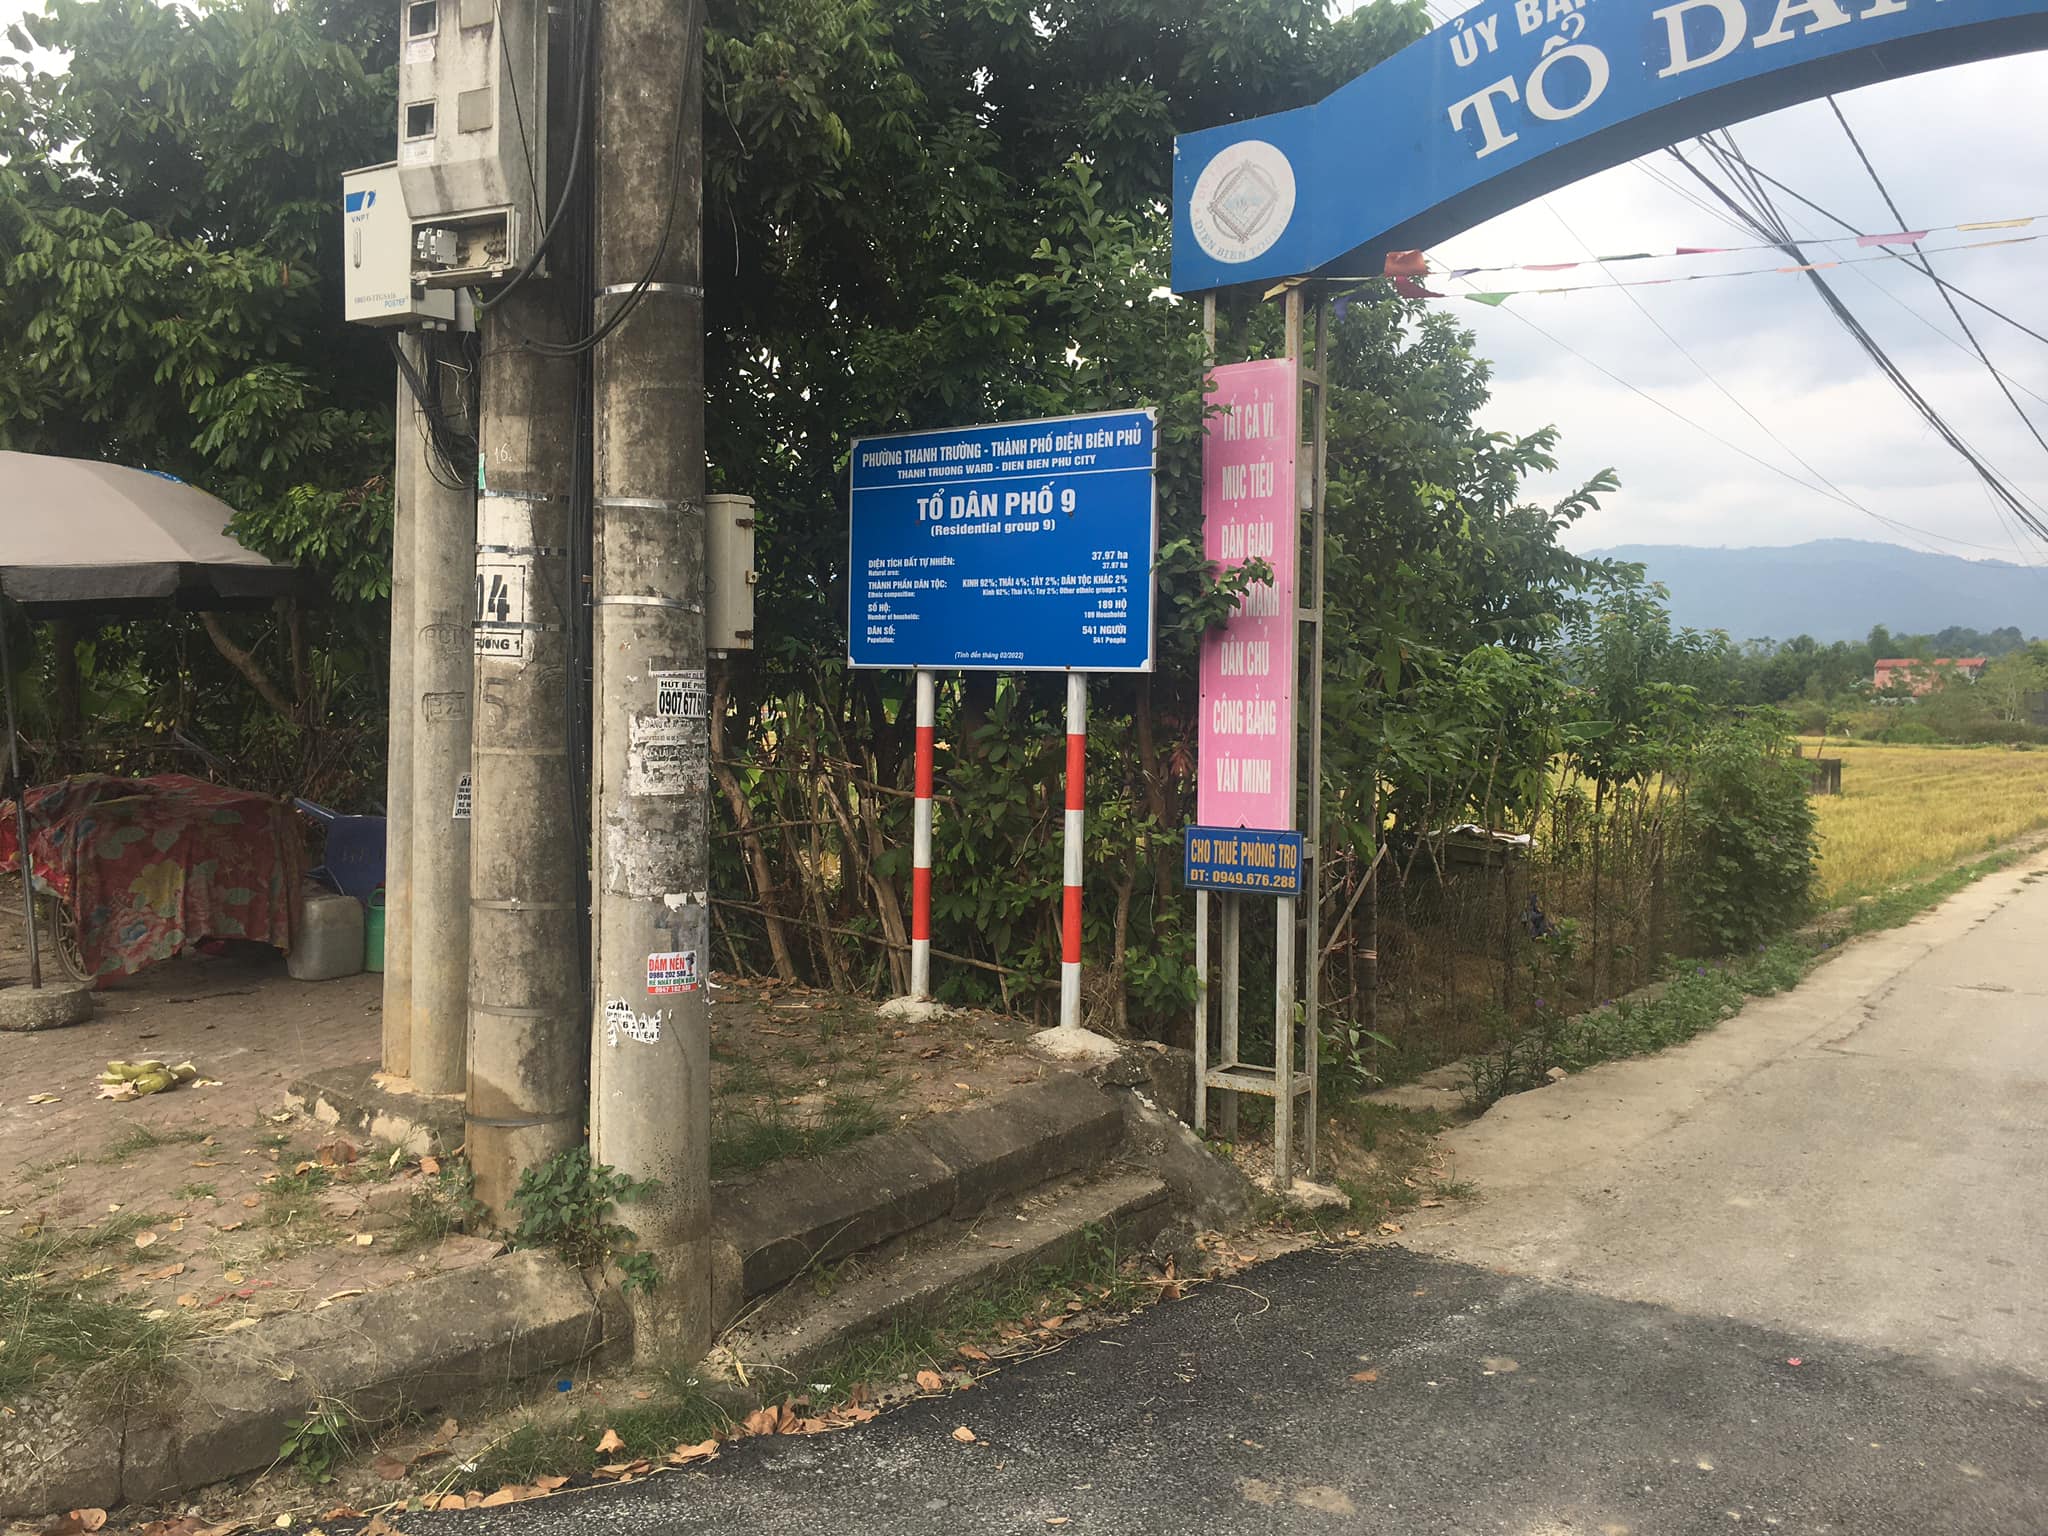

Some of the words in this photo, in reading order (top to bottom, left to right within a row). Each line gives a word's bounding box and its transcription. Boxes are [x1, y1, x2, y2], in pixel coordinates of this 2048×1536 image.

[1450, 14, 1498, 67] ỦY
[1448, 12, 1610, 160] TỔ
[1245, 388, 1259, 440] CẢ
[862, 447, 902, 468] PHƯỜNG
[904, 447, 937, 465] THANH
[940, 440, 981, 461] TRƯỜNG
[991, 437, 1027, 457] THÀNH
[1030, 431, 1053, 454] PHỐ
[1055, 431, 1082, 454] ĐIỆN
[1086, 428, 1113, 449] BIÊN
[1117, 421, 1142, 446] PHỦ
[897, 468, 926, 480] THANH
[928, 466, 963, 477] TRUONG
[965, 463, 993, 474] WARD
[1002, 460, 1024, 471] DIEN
[1027, 458, 1049, 470] BIEN
[1052, 457, 1071, 467] PHU
[1074, 455, 1096, 465] CITY
[1222, 464, 1246, 508] MỤC
[917, 488, 945, 520] TỔ
[950, 490, 998, 519] DÂN
[1005, 481, 1055, 516] PHỐ
[1061, 488, 1076, 513] 9
[931, 522, 1001, 537] (Residential
[1004, 521, 1039, 534] group
[1042, 519, 1055, 531] 9)
[1220, 516, 1244, 560] DÂN
[887, 558, 902, 568] TÍCH
[1117, 551, 1128, 559] ha
[868, 579, 892, 590] THÀNH
[914, 579, 929, 588] DÂN
[1061, 575, 1076, 584] DÂN
[1078, 574, 1092, 586] TỘC
[1093, 573, 1113, 584] KHÁC
[1115, 575, 1127, 583] 2%
[868, 601, 877, 612] SỐ
[879, 602, 891, 613] HỘ:
[1115, 598, 1127, 610] HỘ
[867, 625, 882, 635] DÂN
[884, 624, 896, 635] SỐ:
[1220, 634, 1244, 676] DÂN
[1247, 624, 1270, 677] CHỦ
[1213, 692, 1243, 735] CÔNG
[1216, 752, 1239, 793] VĂN
[1241, 758, 1271, 794] MINH
[1191, 838, 1211, 863] CHO
[1241, 836, 1275, 868] PHÒNG
[1278, 844, 1297, 875] TRỌ
[1212, 870, 1296, 888] 0949.676.288
